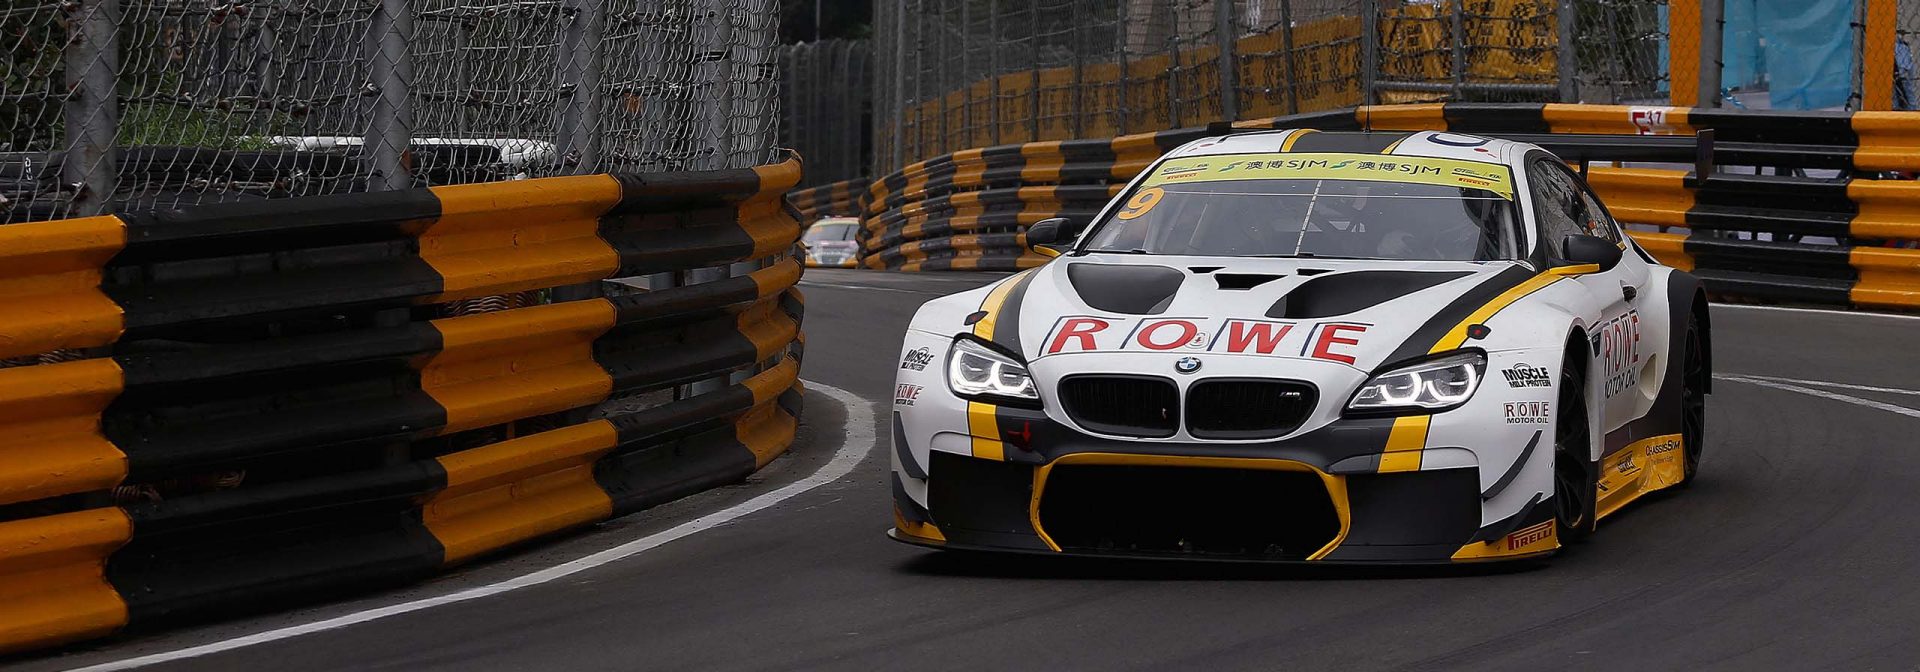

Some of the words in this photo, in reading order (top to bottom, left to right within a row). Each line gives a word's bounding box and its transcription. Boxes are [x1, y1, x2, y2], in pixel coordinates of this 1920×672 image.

[1245, 160, 1284, 170] 澳博
[1286, 160, 1328, 170] SJM
[1356, 160, 1397, 171] 澳博
[1399, 163, 1442, 175] SJM
[1117, 187, 1165, 220] 9
[1048, 317, 1368, 365] ROWE
[1603, 313, 1640, 378] ROWE
[1501, 367, 1550, 381] MUSCLE
[1525, 379, 1552, 387] PROTEIN
[896, 384, 924, 400] ROWE
[1504, 403, 1549, 417] ROWE
[1507, 521, 1553, 551] PIRELLI
